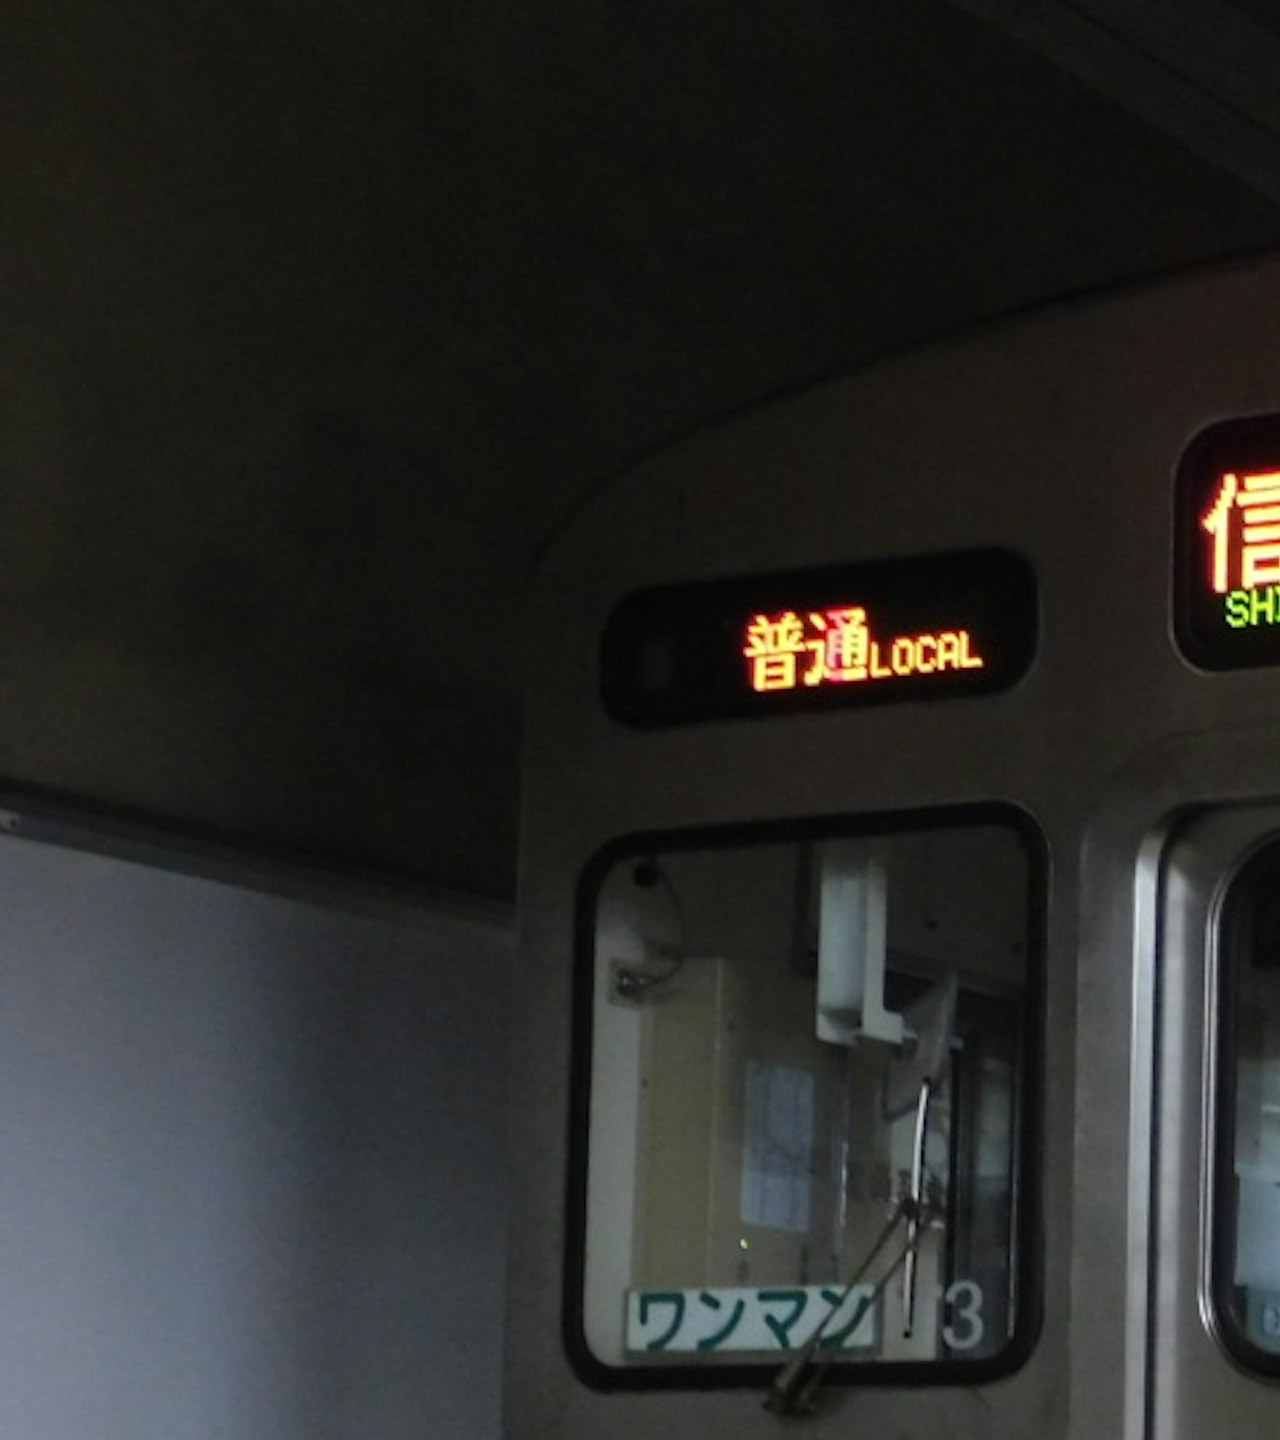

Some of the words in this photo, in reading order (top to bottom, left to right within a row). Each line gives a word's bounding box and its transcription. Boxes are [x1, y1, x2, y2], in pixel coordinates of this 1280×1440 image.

[743, 606, 869, 693] 普通
[870, 630, 983, 678] LOCAL
[638, 1290, 869, 1350] ワンマン
[942, 1280, 985, 1350] 3
